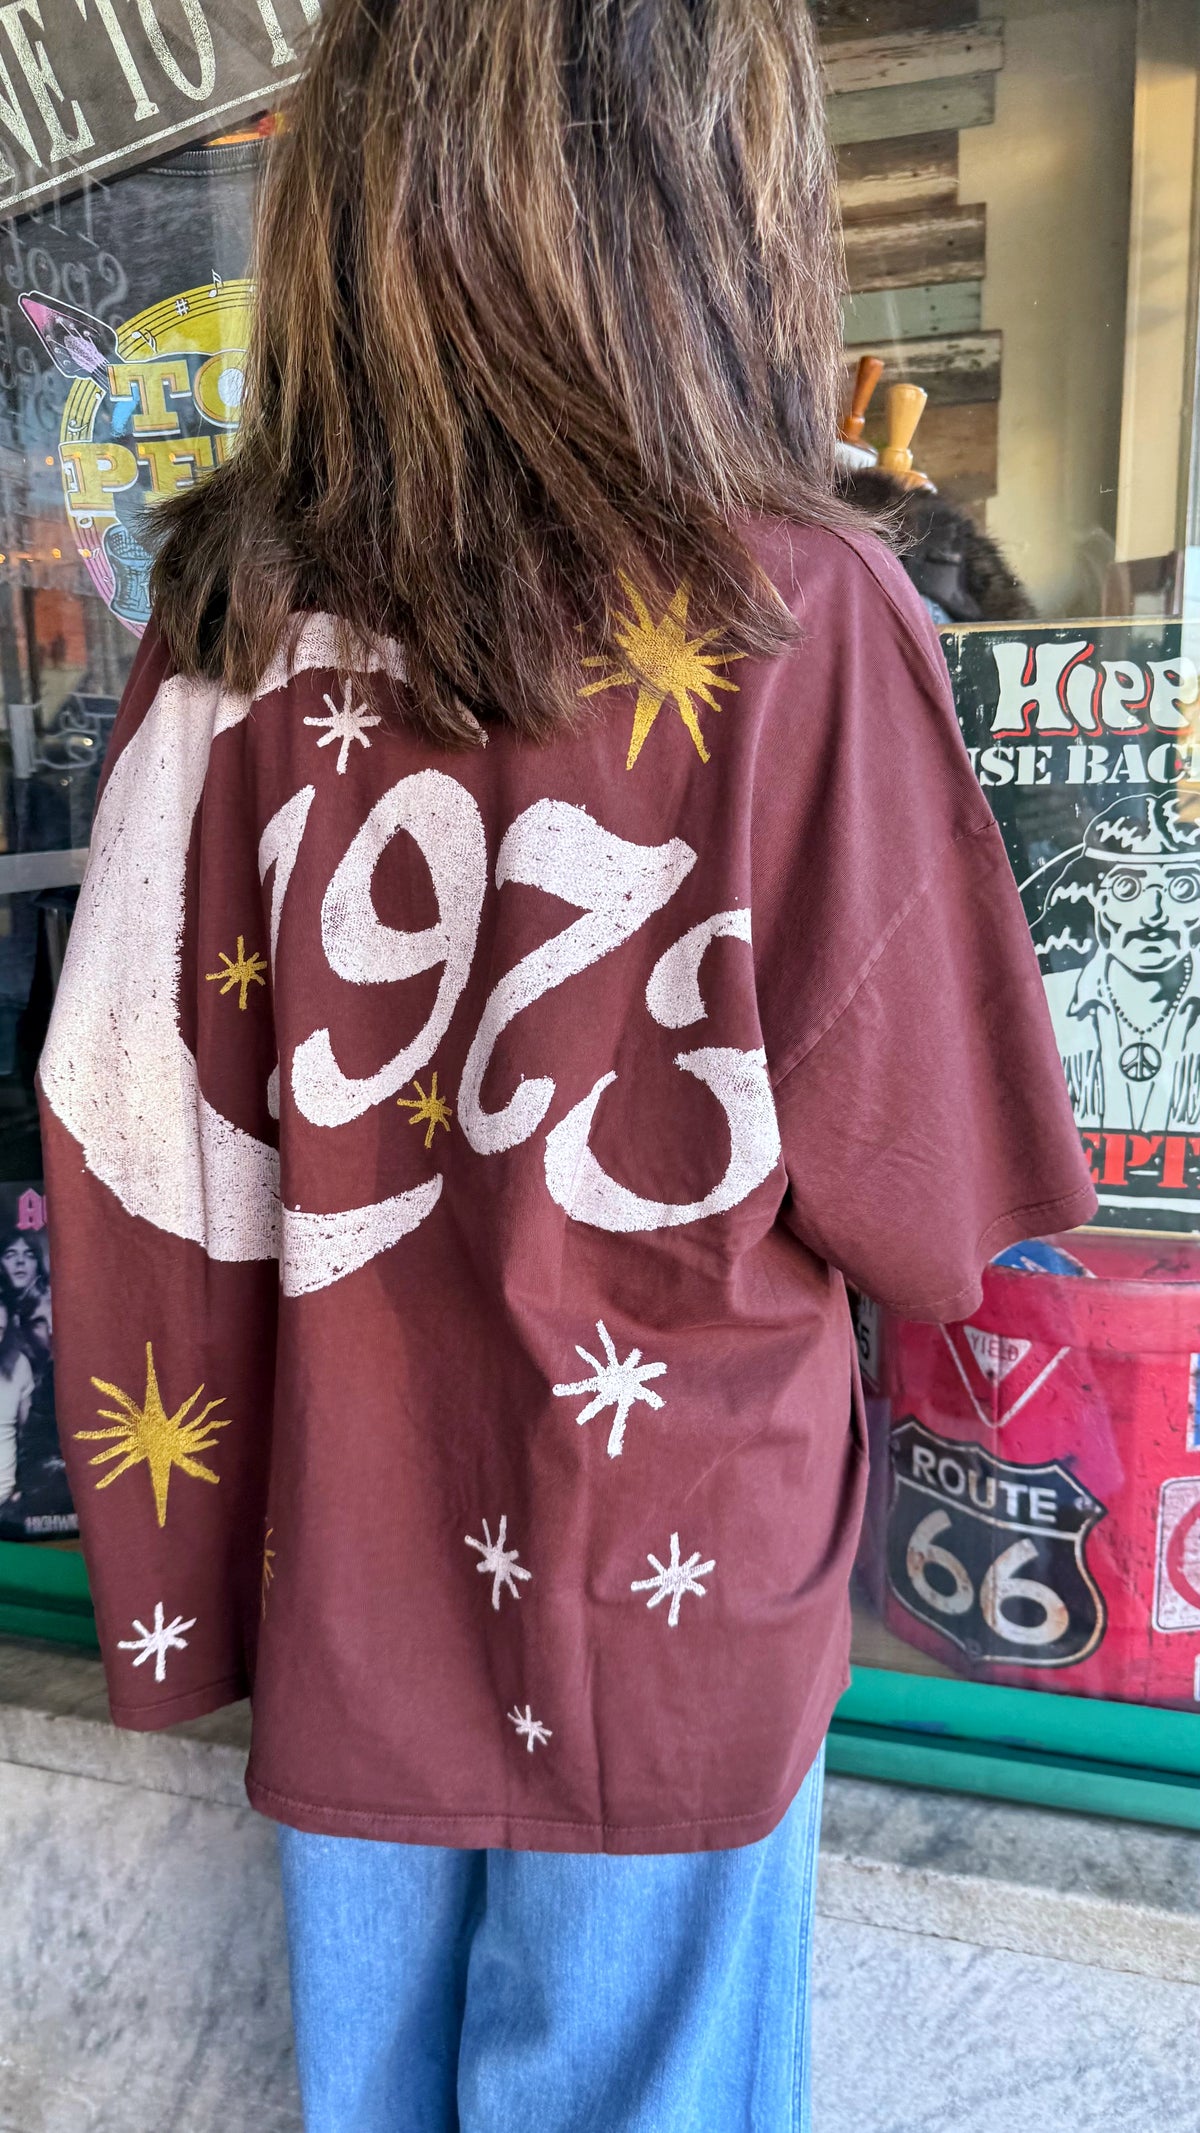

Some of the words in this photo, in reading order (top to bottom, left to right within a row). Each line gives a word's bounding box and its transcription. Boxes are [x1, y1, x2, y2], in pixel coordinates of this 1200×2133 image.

[258, 768, 782, 1233] 1973
[911, 1445, 1058, 1523] ROUTE
[906, 1508, 1070, 1646] 66
